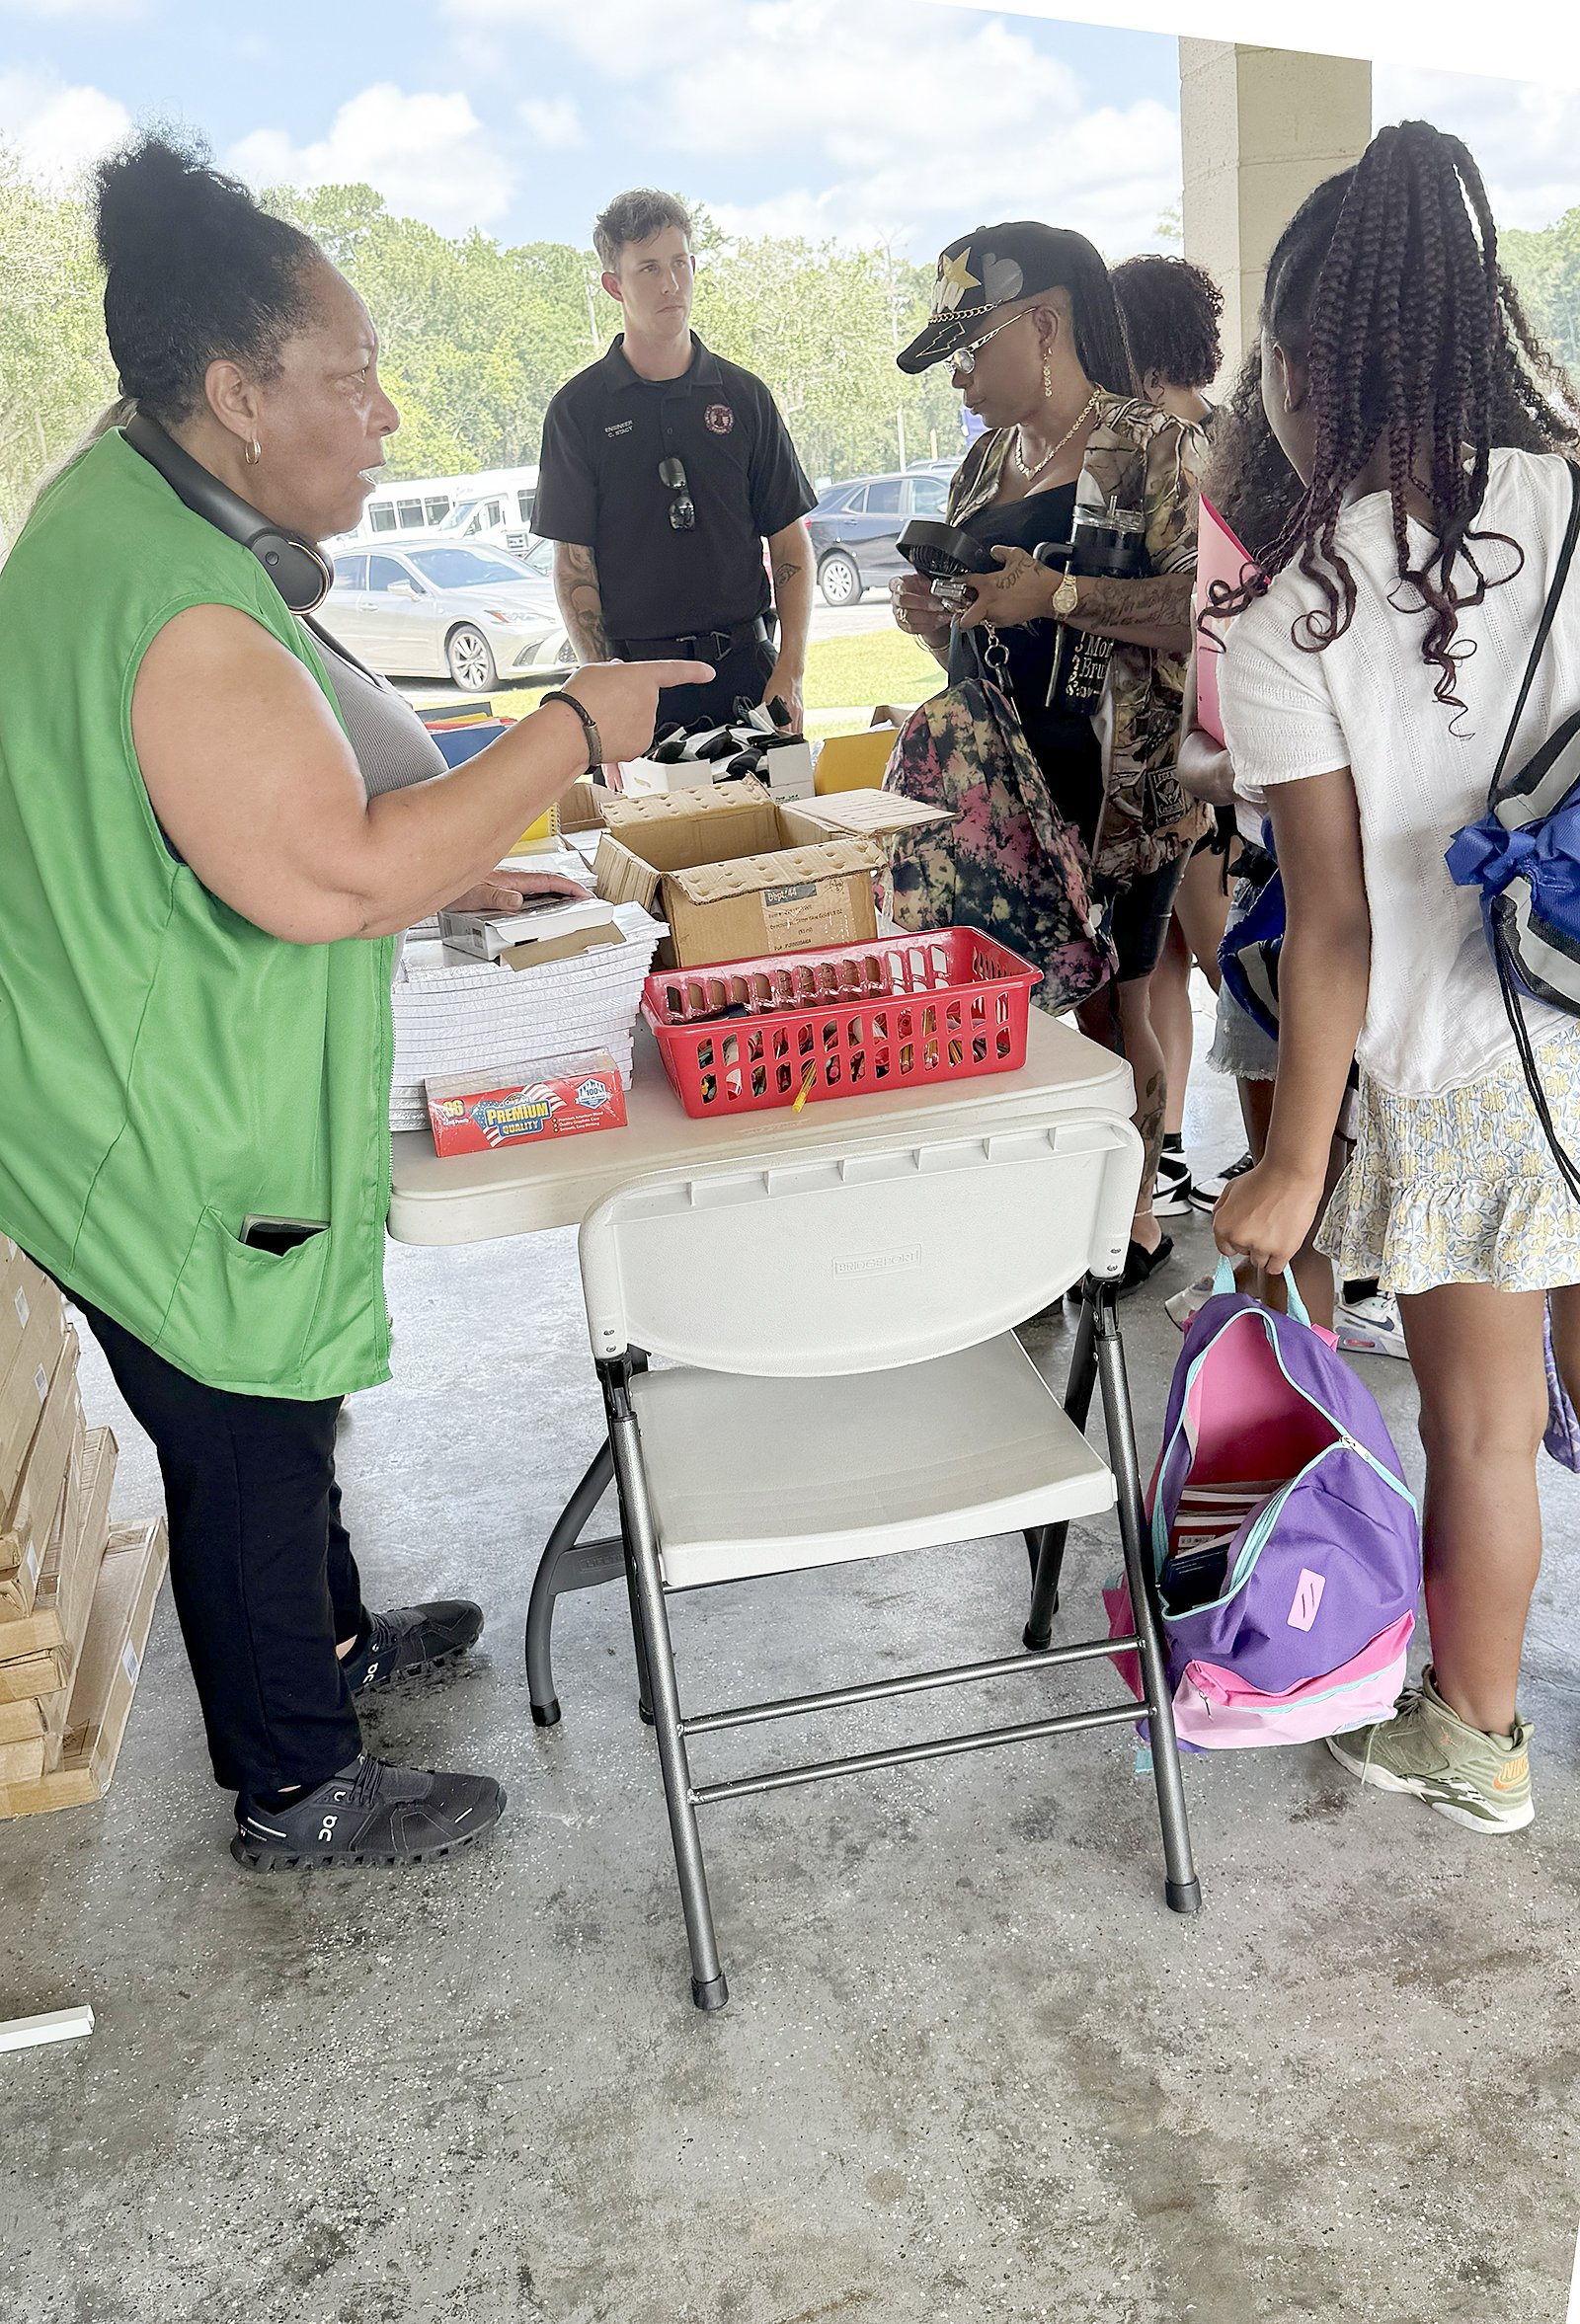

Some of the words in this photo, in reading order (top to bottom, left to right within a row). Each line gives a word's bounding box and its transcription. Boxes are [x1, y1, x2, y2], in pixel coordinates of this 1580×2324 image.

[487, 1102, 549, 1125] PREMIUM
[502, 1121, 538, 1134] QUALITY
[839, 1253, 914, 1272] BRIDGEPORT
